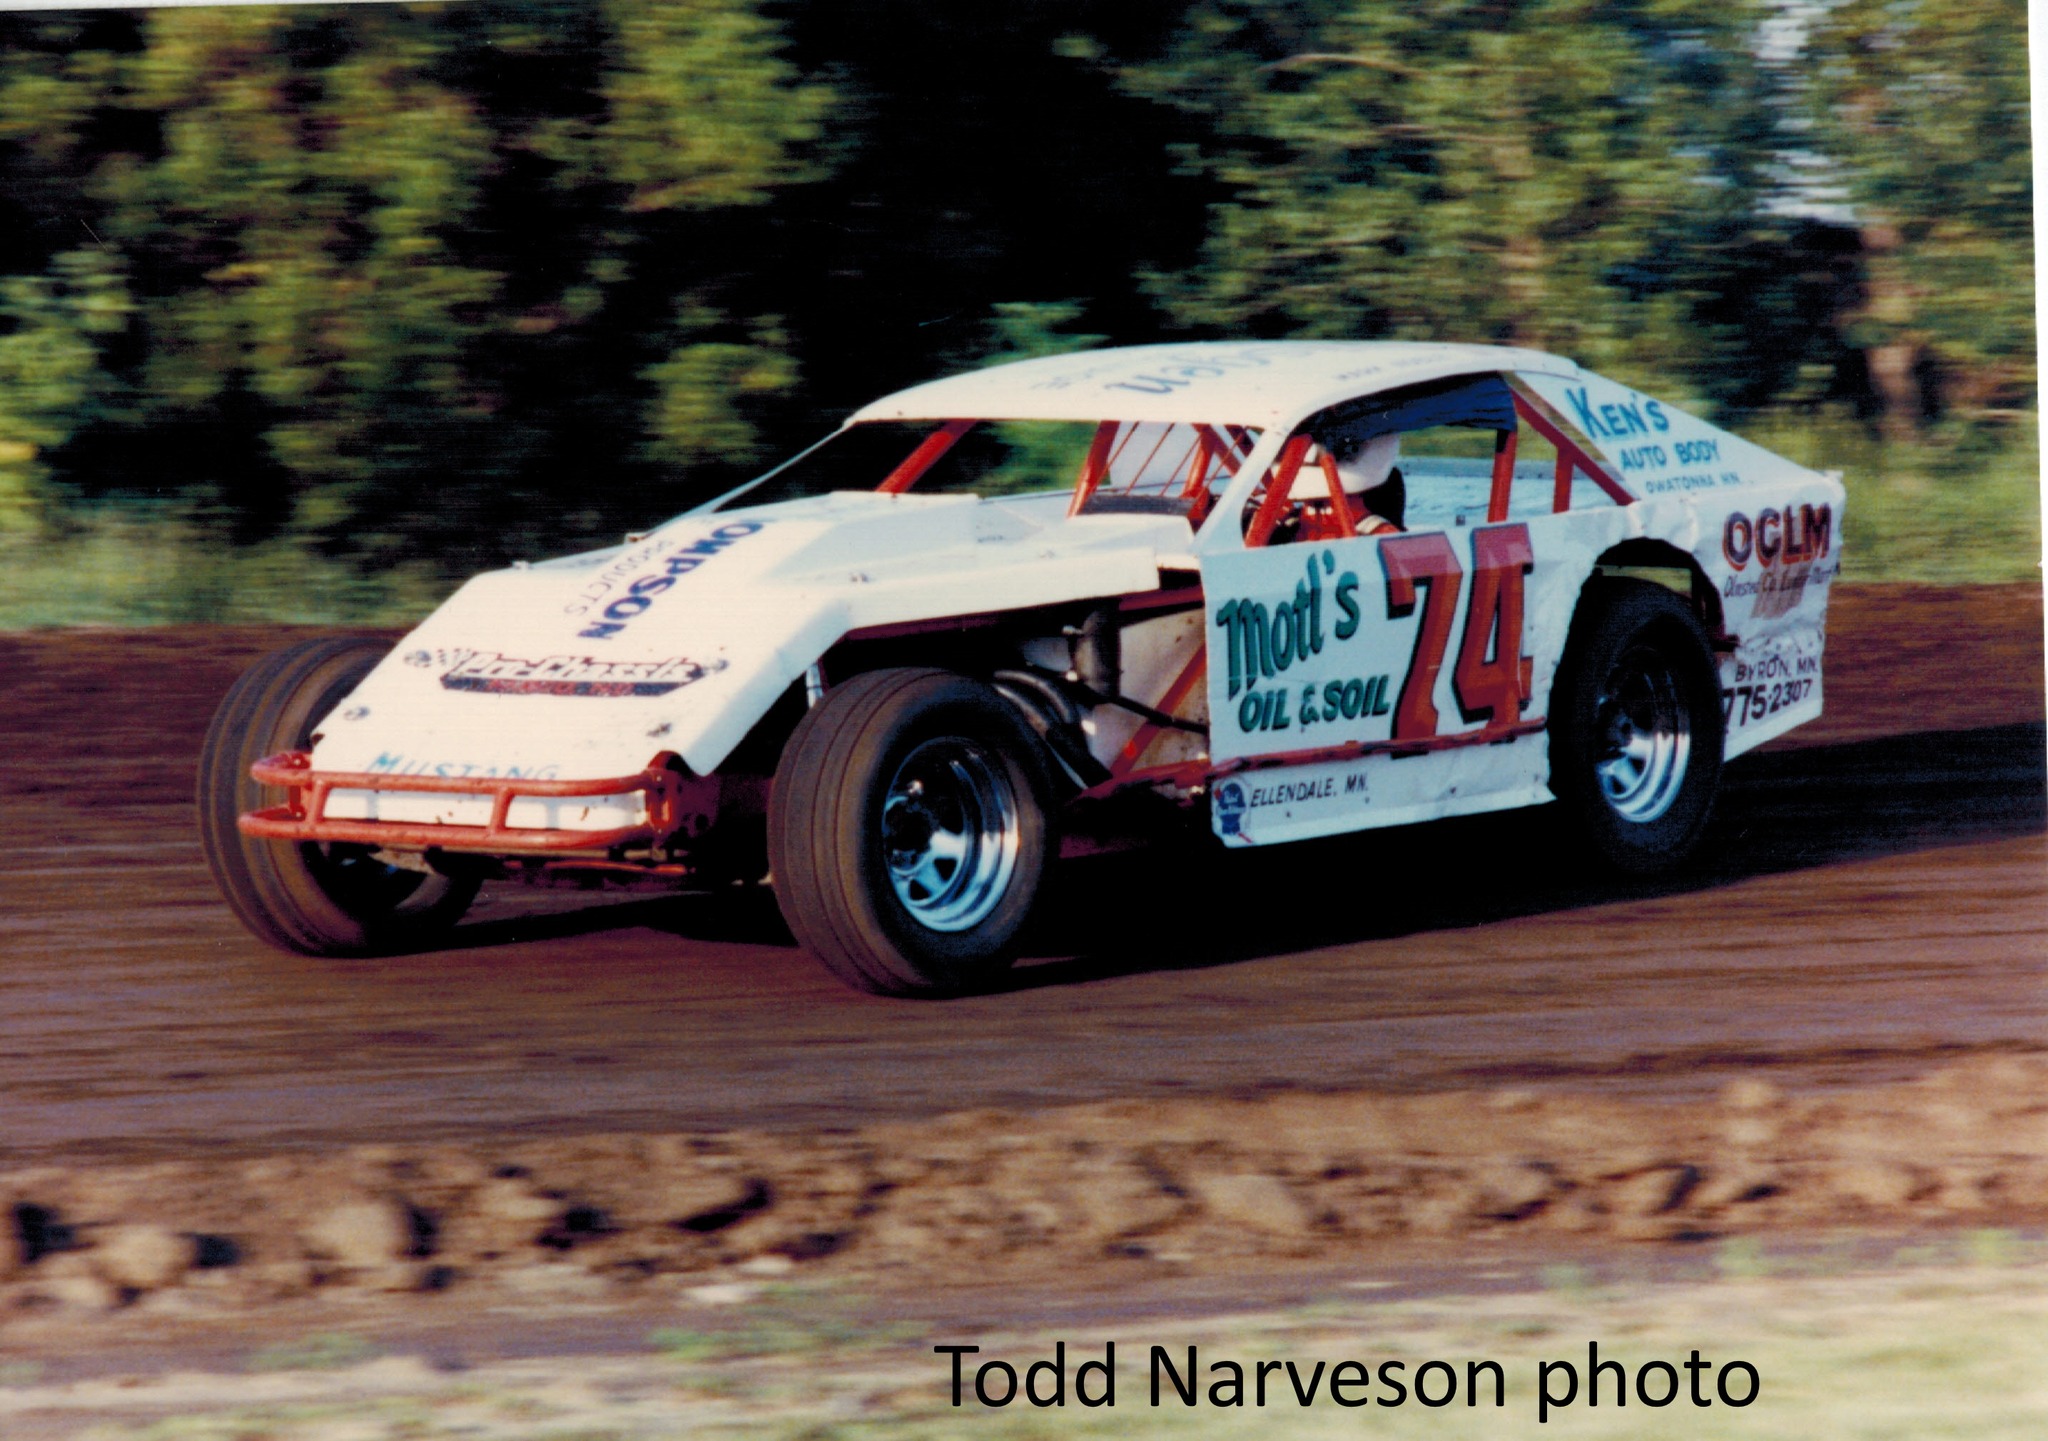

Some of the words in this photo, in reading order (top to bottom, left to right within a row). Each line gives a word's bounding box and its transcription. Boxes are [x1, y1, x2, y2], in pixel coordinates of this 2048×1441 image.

[1565, 387, 1669, 438] KEN'S
[1620, 445, 1667, 470] AUTO
[1674, 440, 1720, 464] BODY
[1645, 475, 1715, 494] OWATONNA
[1722, 502, 1831, 572] OCLM
[1377, 522, 1535, 760] 74
[1238, 688, 1291, 733] OIL
[1299, 684, 1320, 726] &
[1322, 674, 1390, 722] SOIL
[364, 752, 561, 781] MUSTANG
